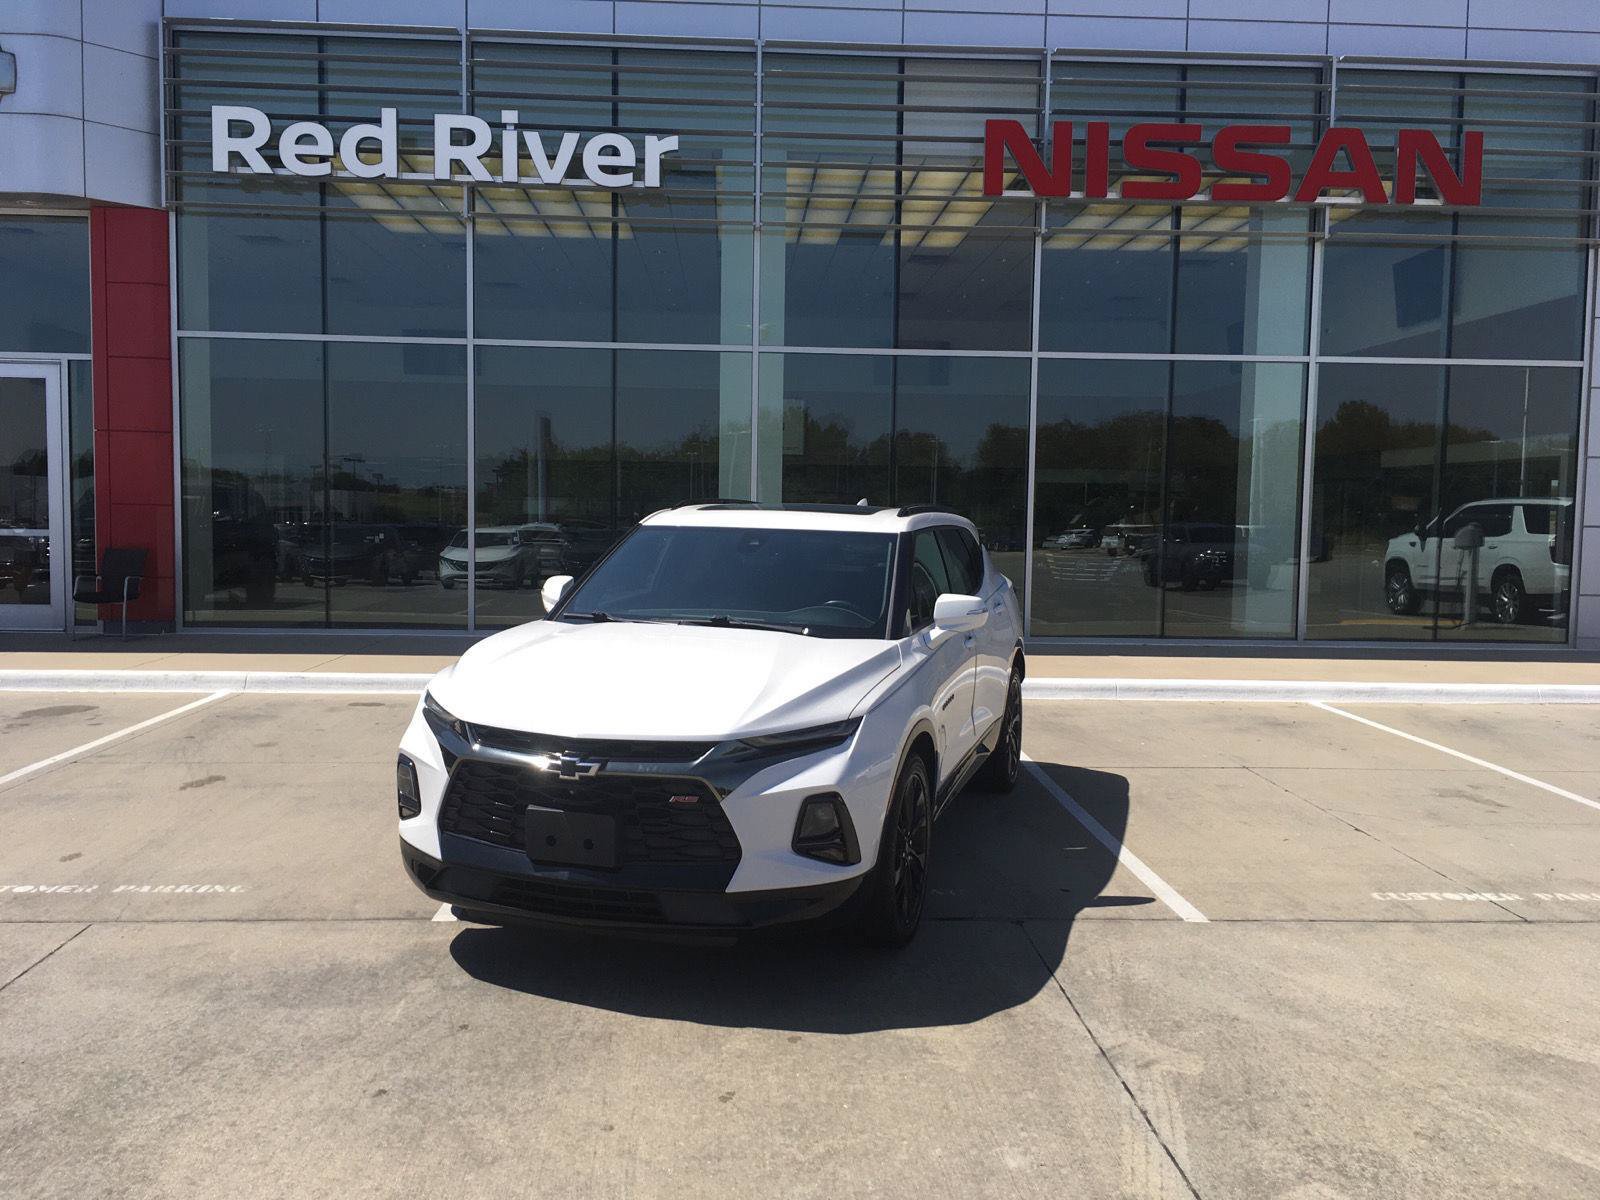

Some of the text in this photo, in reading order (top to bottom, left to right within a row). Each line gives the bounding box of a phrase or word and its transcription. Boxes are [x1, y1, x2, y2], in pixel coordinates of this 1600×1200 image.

[211, 105, 679, 188] Red River
[983, 119, 1484, 205] NISSAN
[1371, 892, 1524, 901] CUSTOMER
